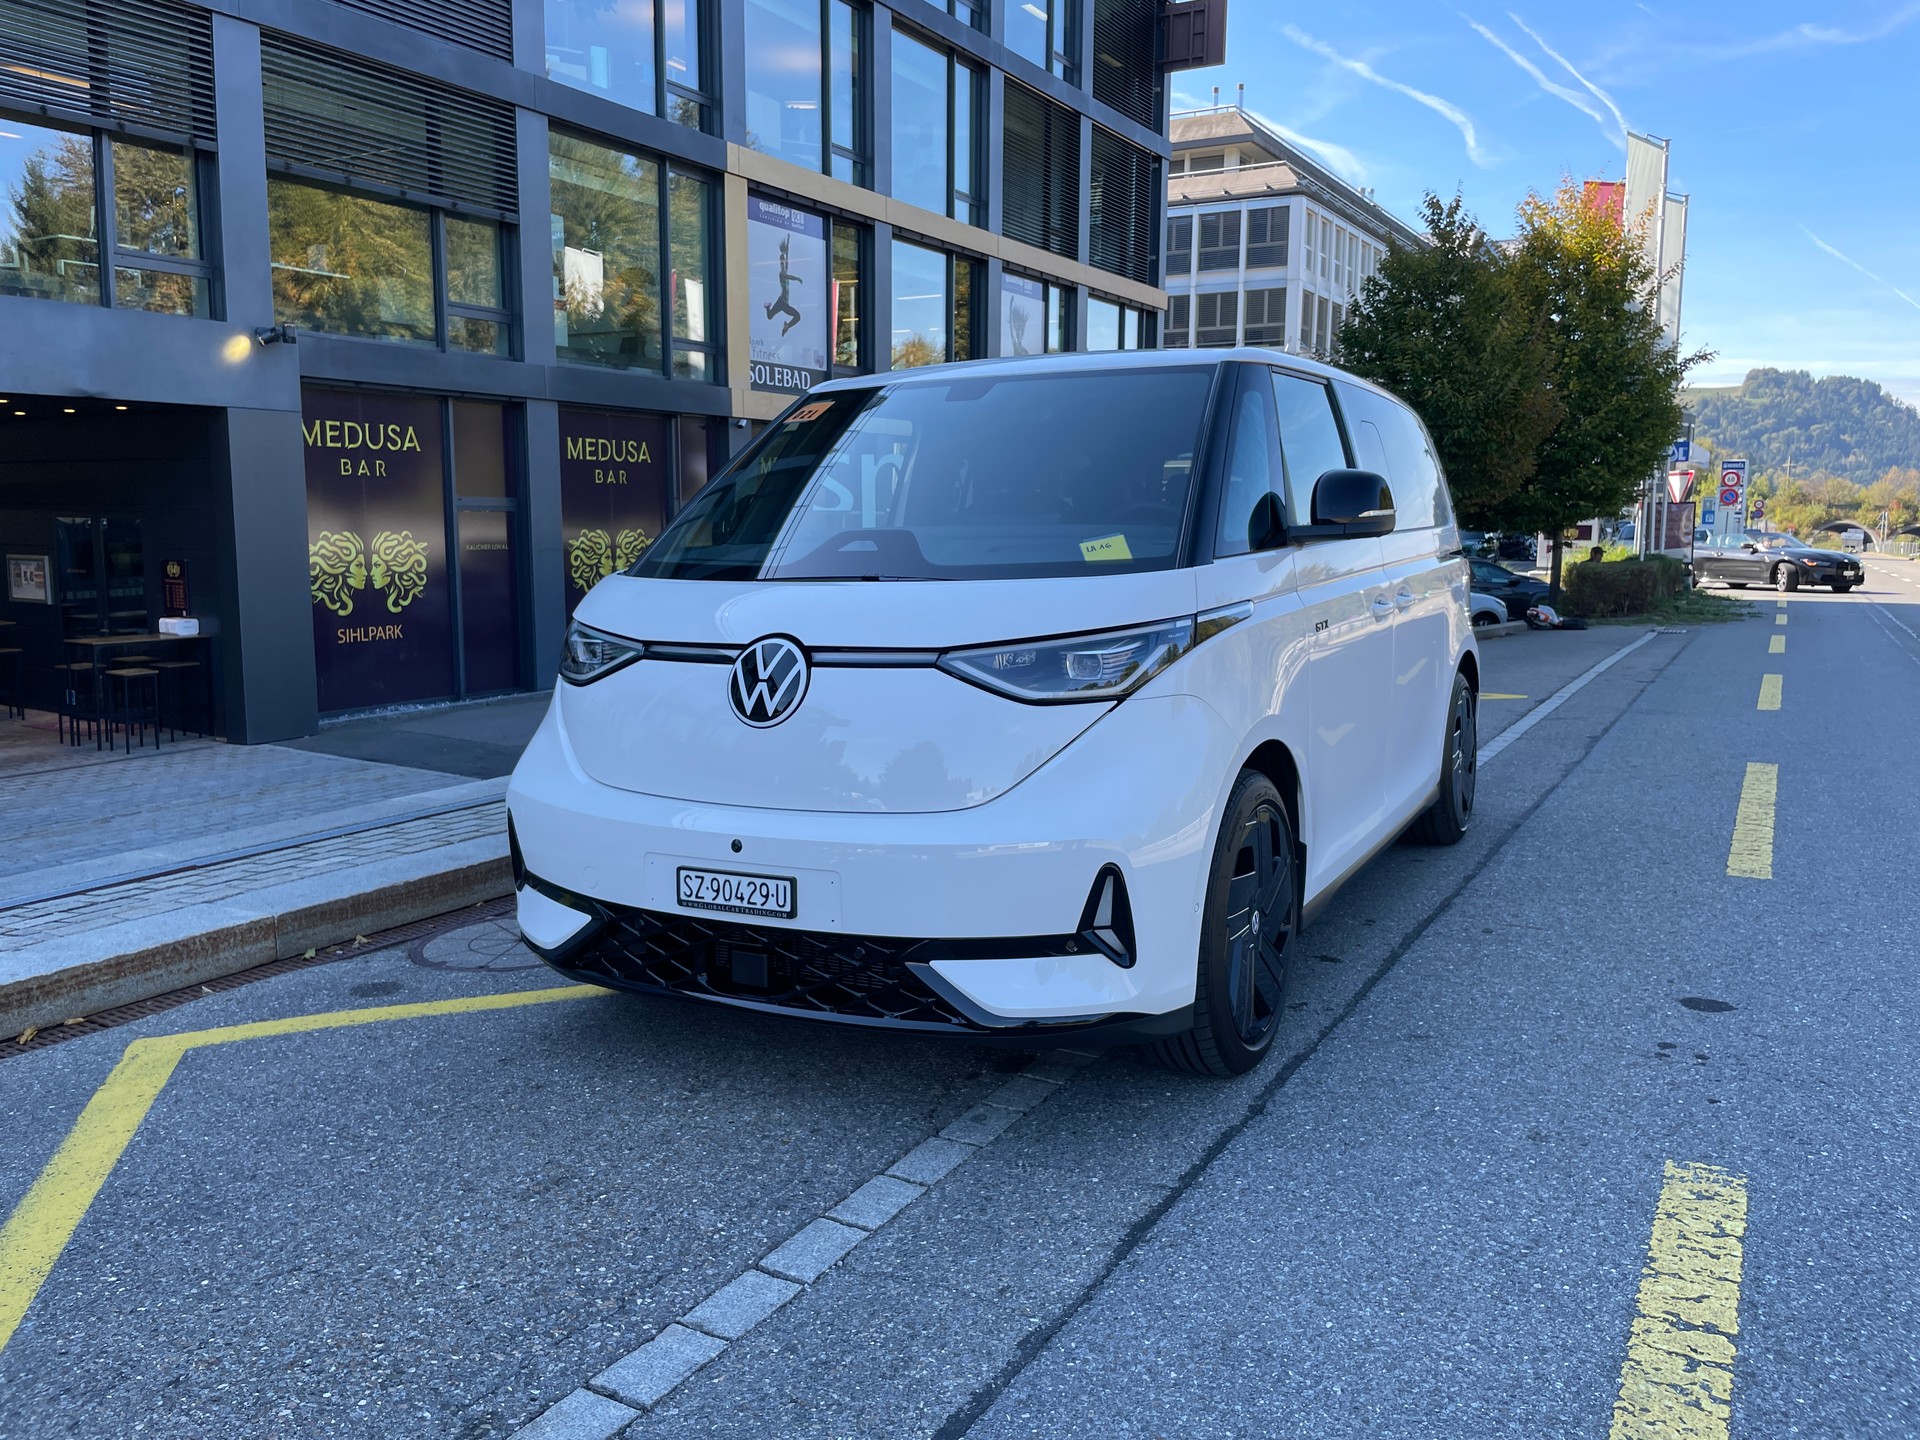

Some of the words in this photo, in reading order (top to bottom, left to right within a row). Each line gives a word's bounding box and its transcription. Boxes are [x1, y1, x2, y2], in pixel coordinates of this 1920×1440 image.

[759, 202, 790, 217] qualitop
[752, 346, 780, 362] fitness
[750, 364, 811, 389] SOLEBAD
[302, 419, 421, 452] MEDUSA
[566, 437, 651, 463] MEDUSA
[340, 458, 387, 477] BAR
[595, 469, 627, 484] BAR
[337, 624, 403, 644] SIHLPARK
[1315, 619, 1329, 633] GTX
